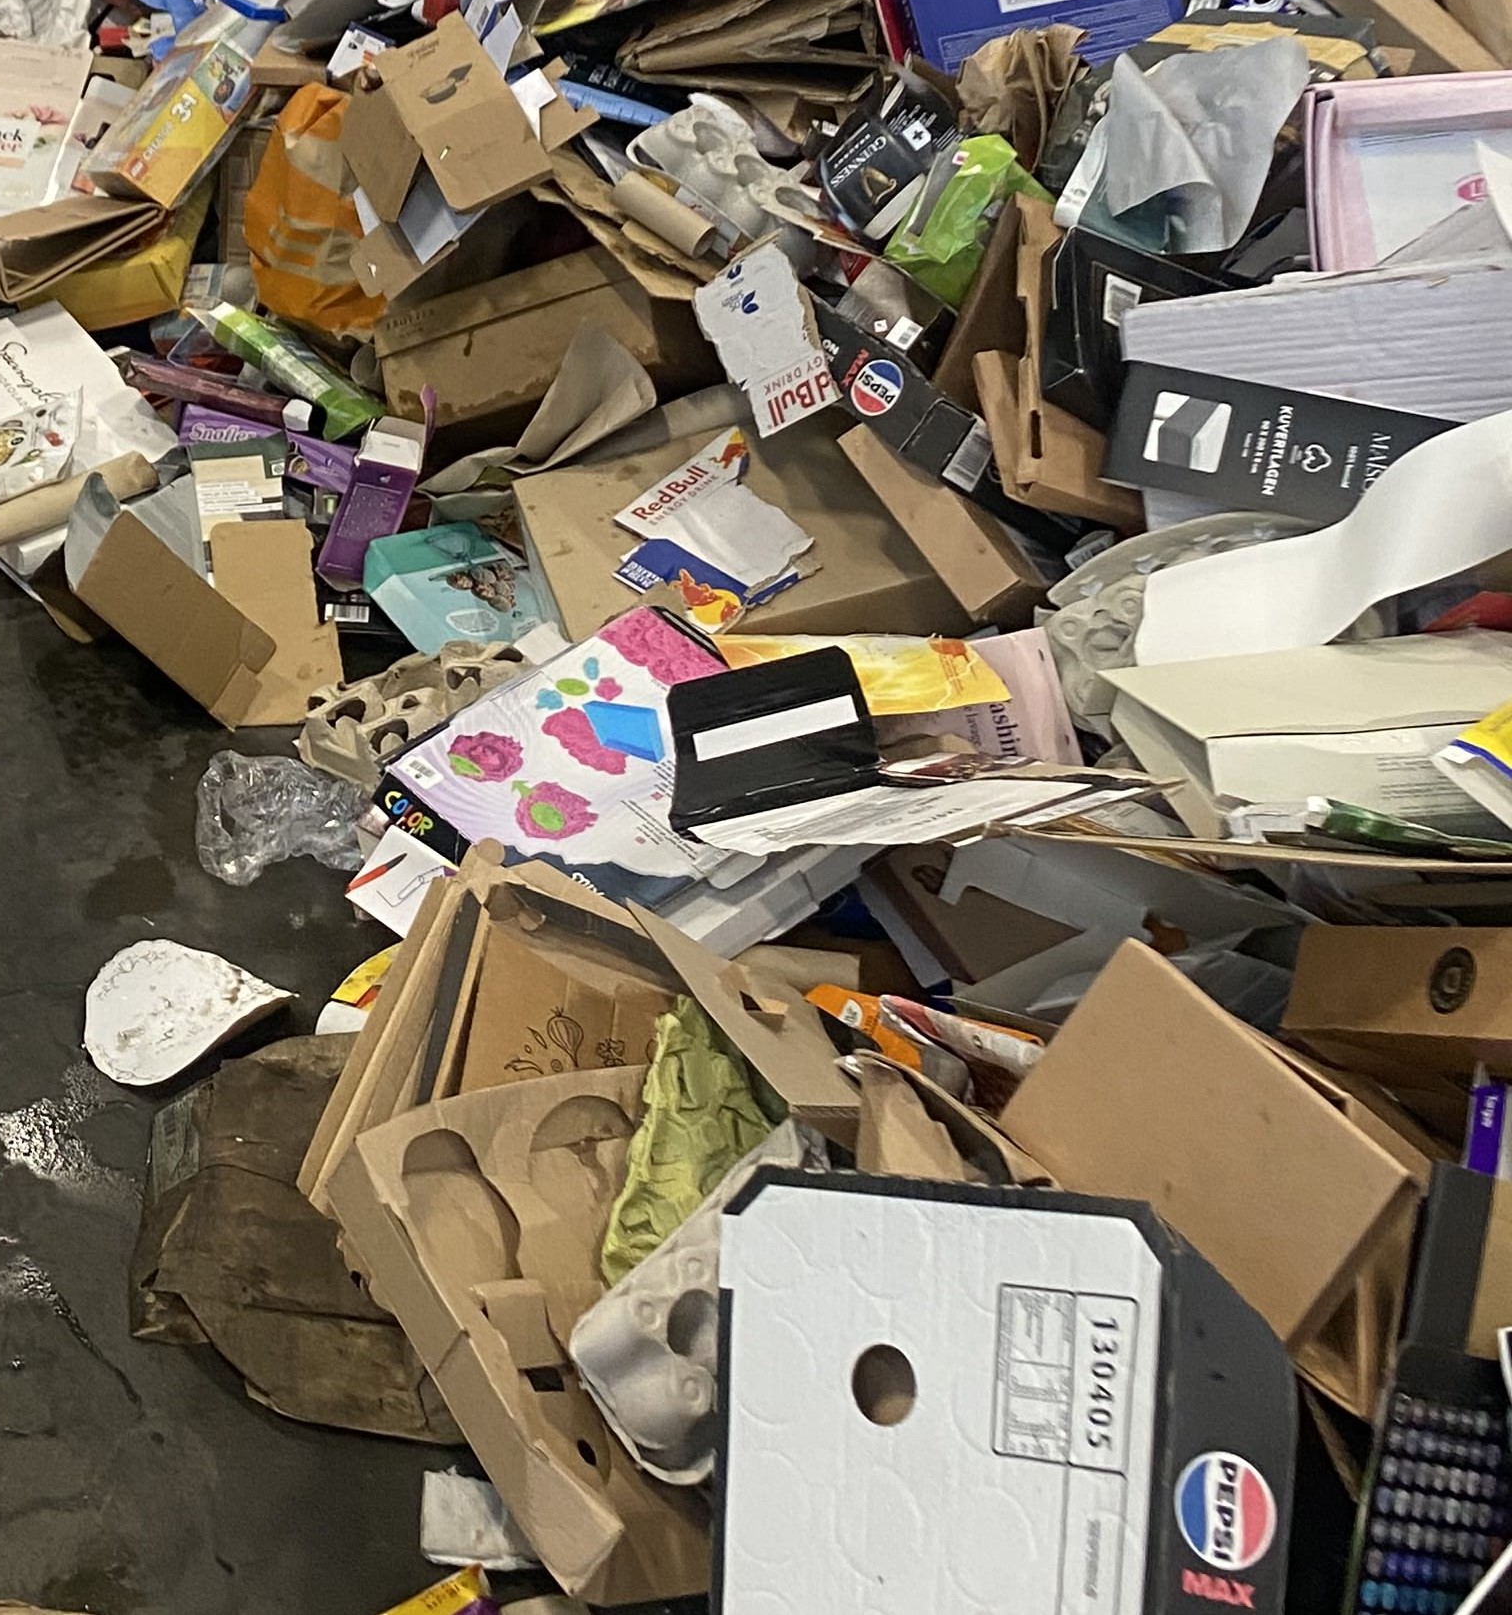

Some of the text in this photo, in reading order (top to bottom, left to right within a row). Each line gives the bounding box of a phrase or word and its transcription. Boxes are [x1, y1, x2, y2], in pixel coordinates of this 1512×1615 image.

[830, 135, 887, 188] GUINNESS
[764, 365, 803, 396] DRINK
[767, 380, 816, 428] Bull
[857, 371, 896, 405] PEPSI
[1261, 405, 1294, 496] KUVERTLAGEN
[631, 463, 710, 521] Red Bull
[689, 474, 720, 498] DRINK
[989, 702, 1021, 756] ashin
[384, 790, 434, 836] COLOR
[1087, 1317, 1119, 1451] 130405
[1182, 1459, 1256, 1609] PEPSI MAX
